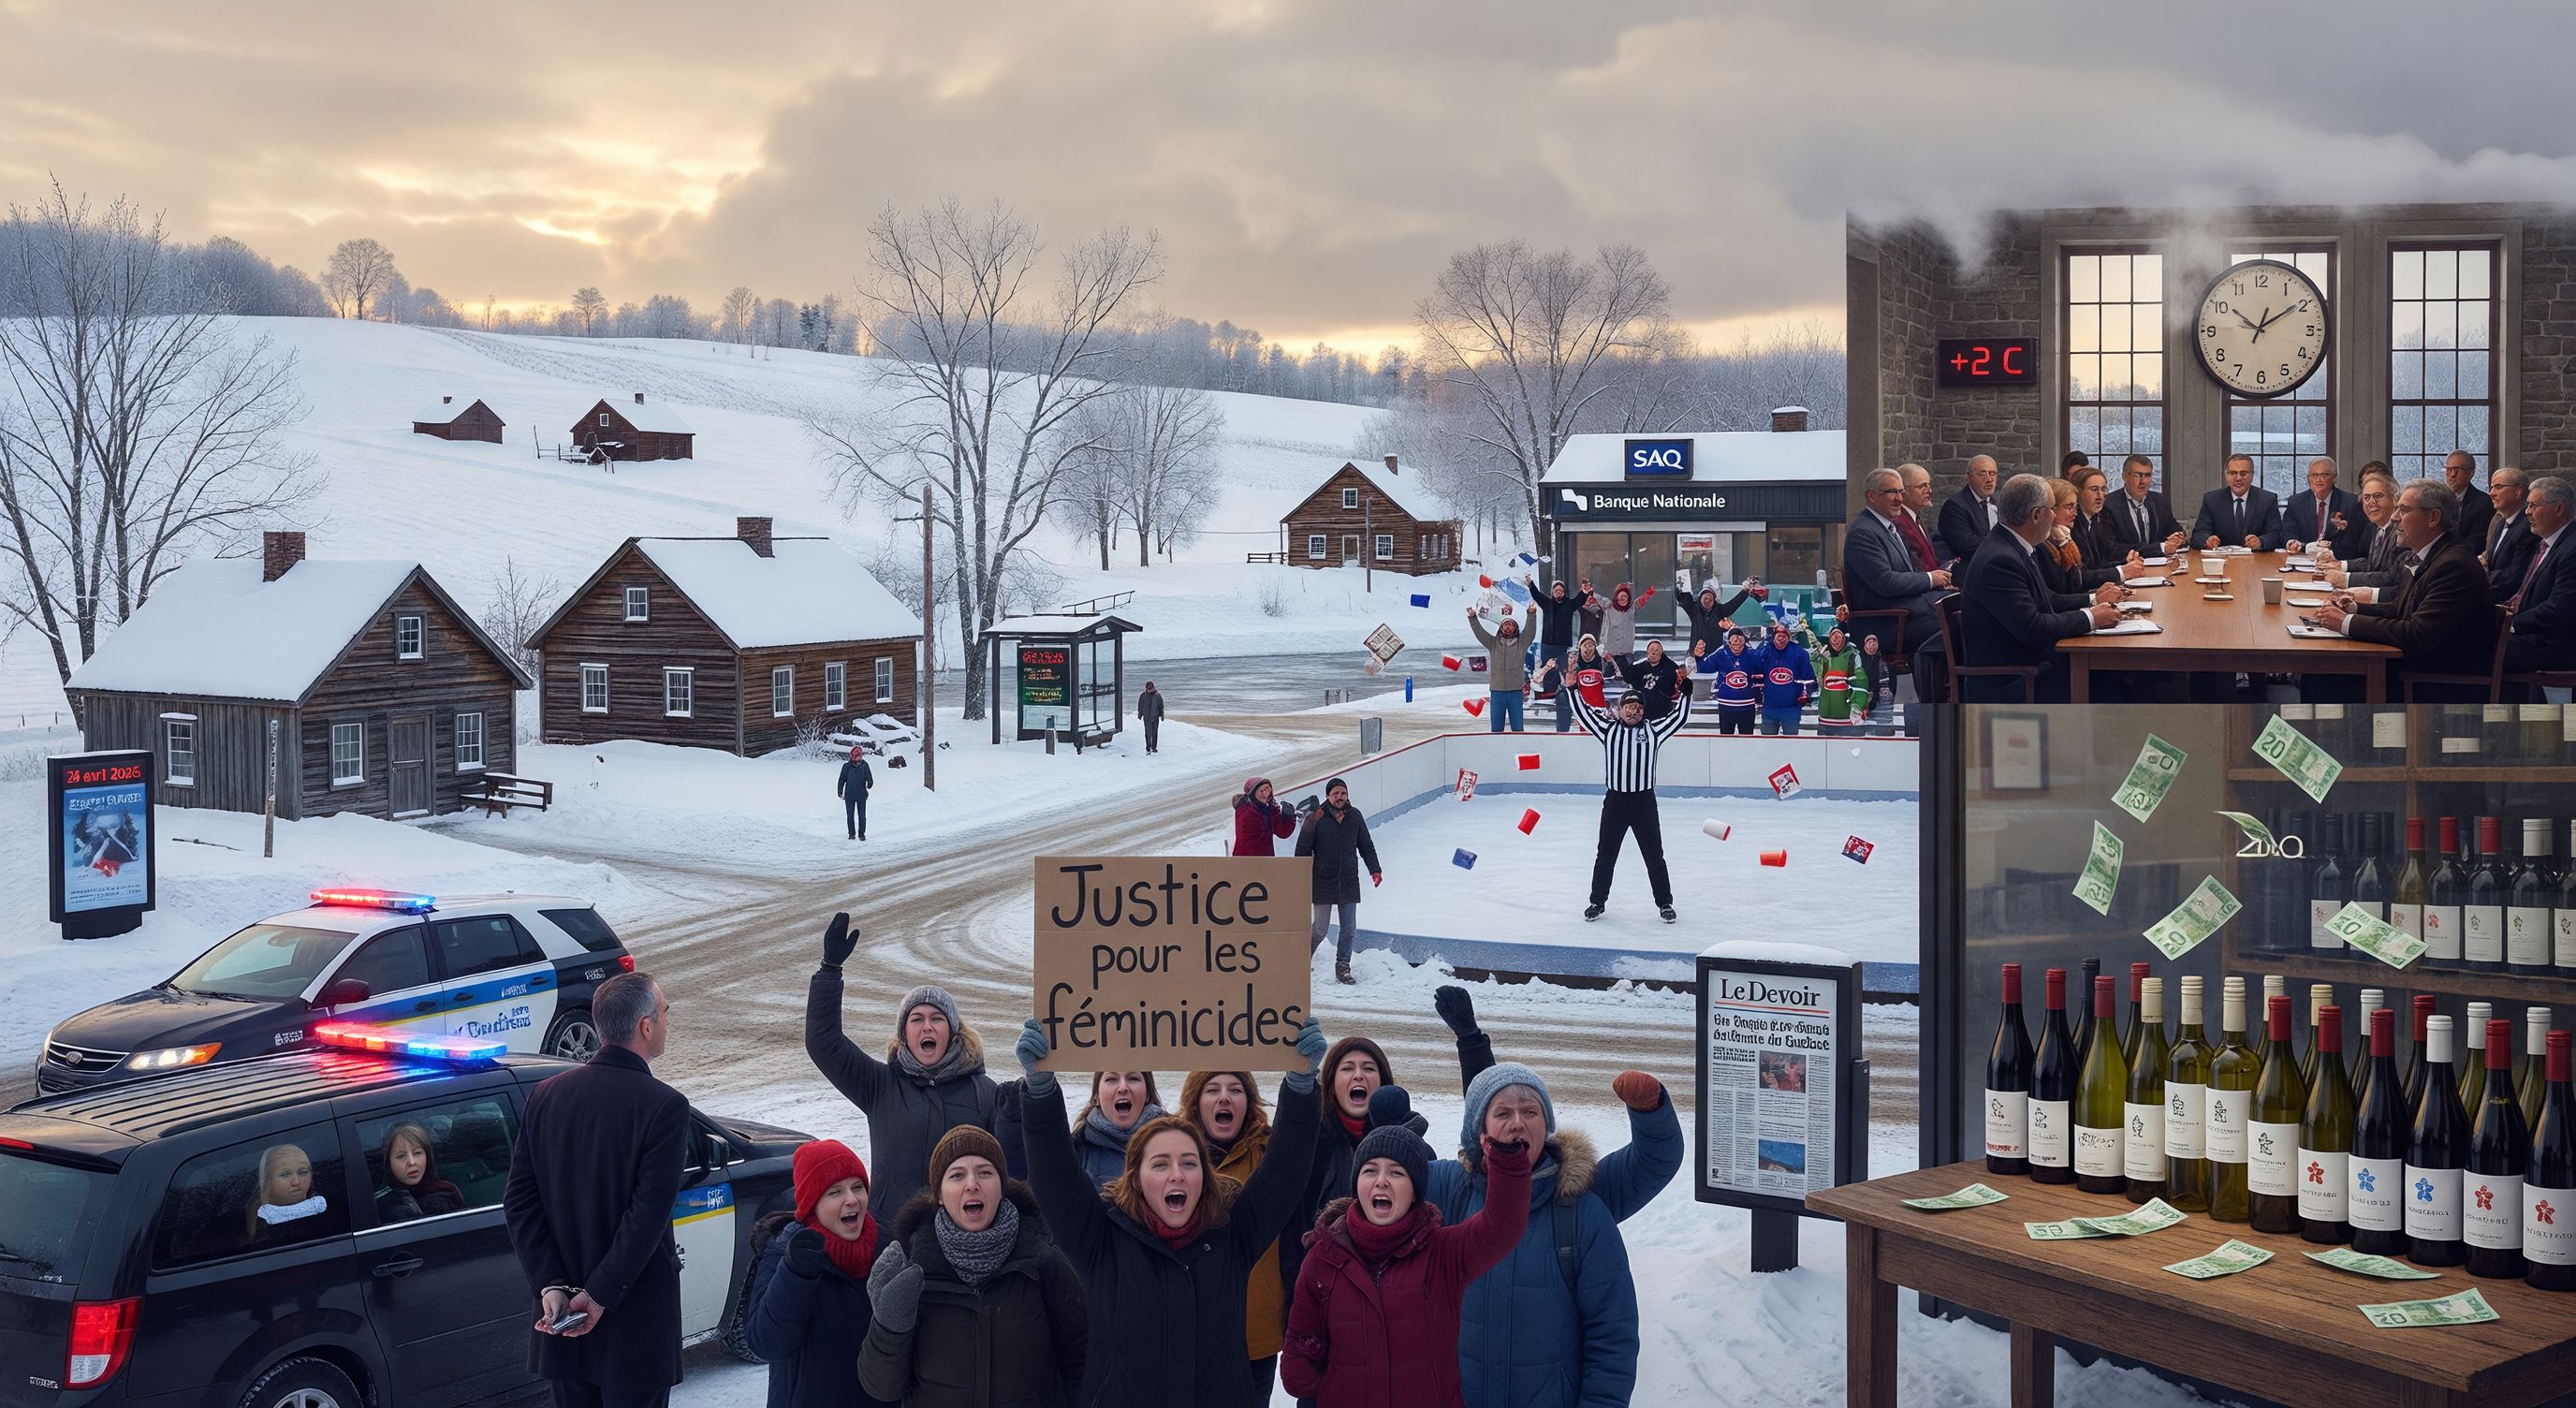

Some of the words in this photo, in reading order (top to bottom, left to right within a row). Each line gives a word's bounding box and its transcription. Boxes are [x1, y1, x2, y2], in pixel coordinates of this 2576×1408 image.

[2254, 274, 2269, 288] 12
[2284, 282, 2288, 297] 1
[2215, 301, 2229, 314] 10
[2298, 300, 2308, 313] 2
[2206, 326, 2217, 338] 9
[2305, 325, 2315, 337] 3
[1951, 346, 1991, 375] +2
[2003, 346, 2023, 374] C
[2216, 348, 2226, 362] 8
[2233, 364, 2244, 377] 7
[2279, 363, 2290, 376] 5
[2256, 371, 2266, 384] 6
[1633, 449, 1684, 470] SAQ
[1594, 494, 1649, 511] Banque
[1653, 492, 1726, 508] Nationale
[2261, 731, 2286, 759] 20
[1051, 863, 1269, 928] Justice
[1091, 944, 1182, 990] pour
[1205, 930, 1261, 973] les
[1720, 978, 1746, 1001] Le
[1748, 980, 1822, 1006] Devoir
[1042, 982, 1305, 1050] féminicides
